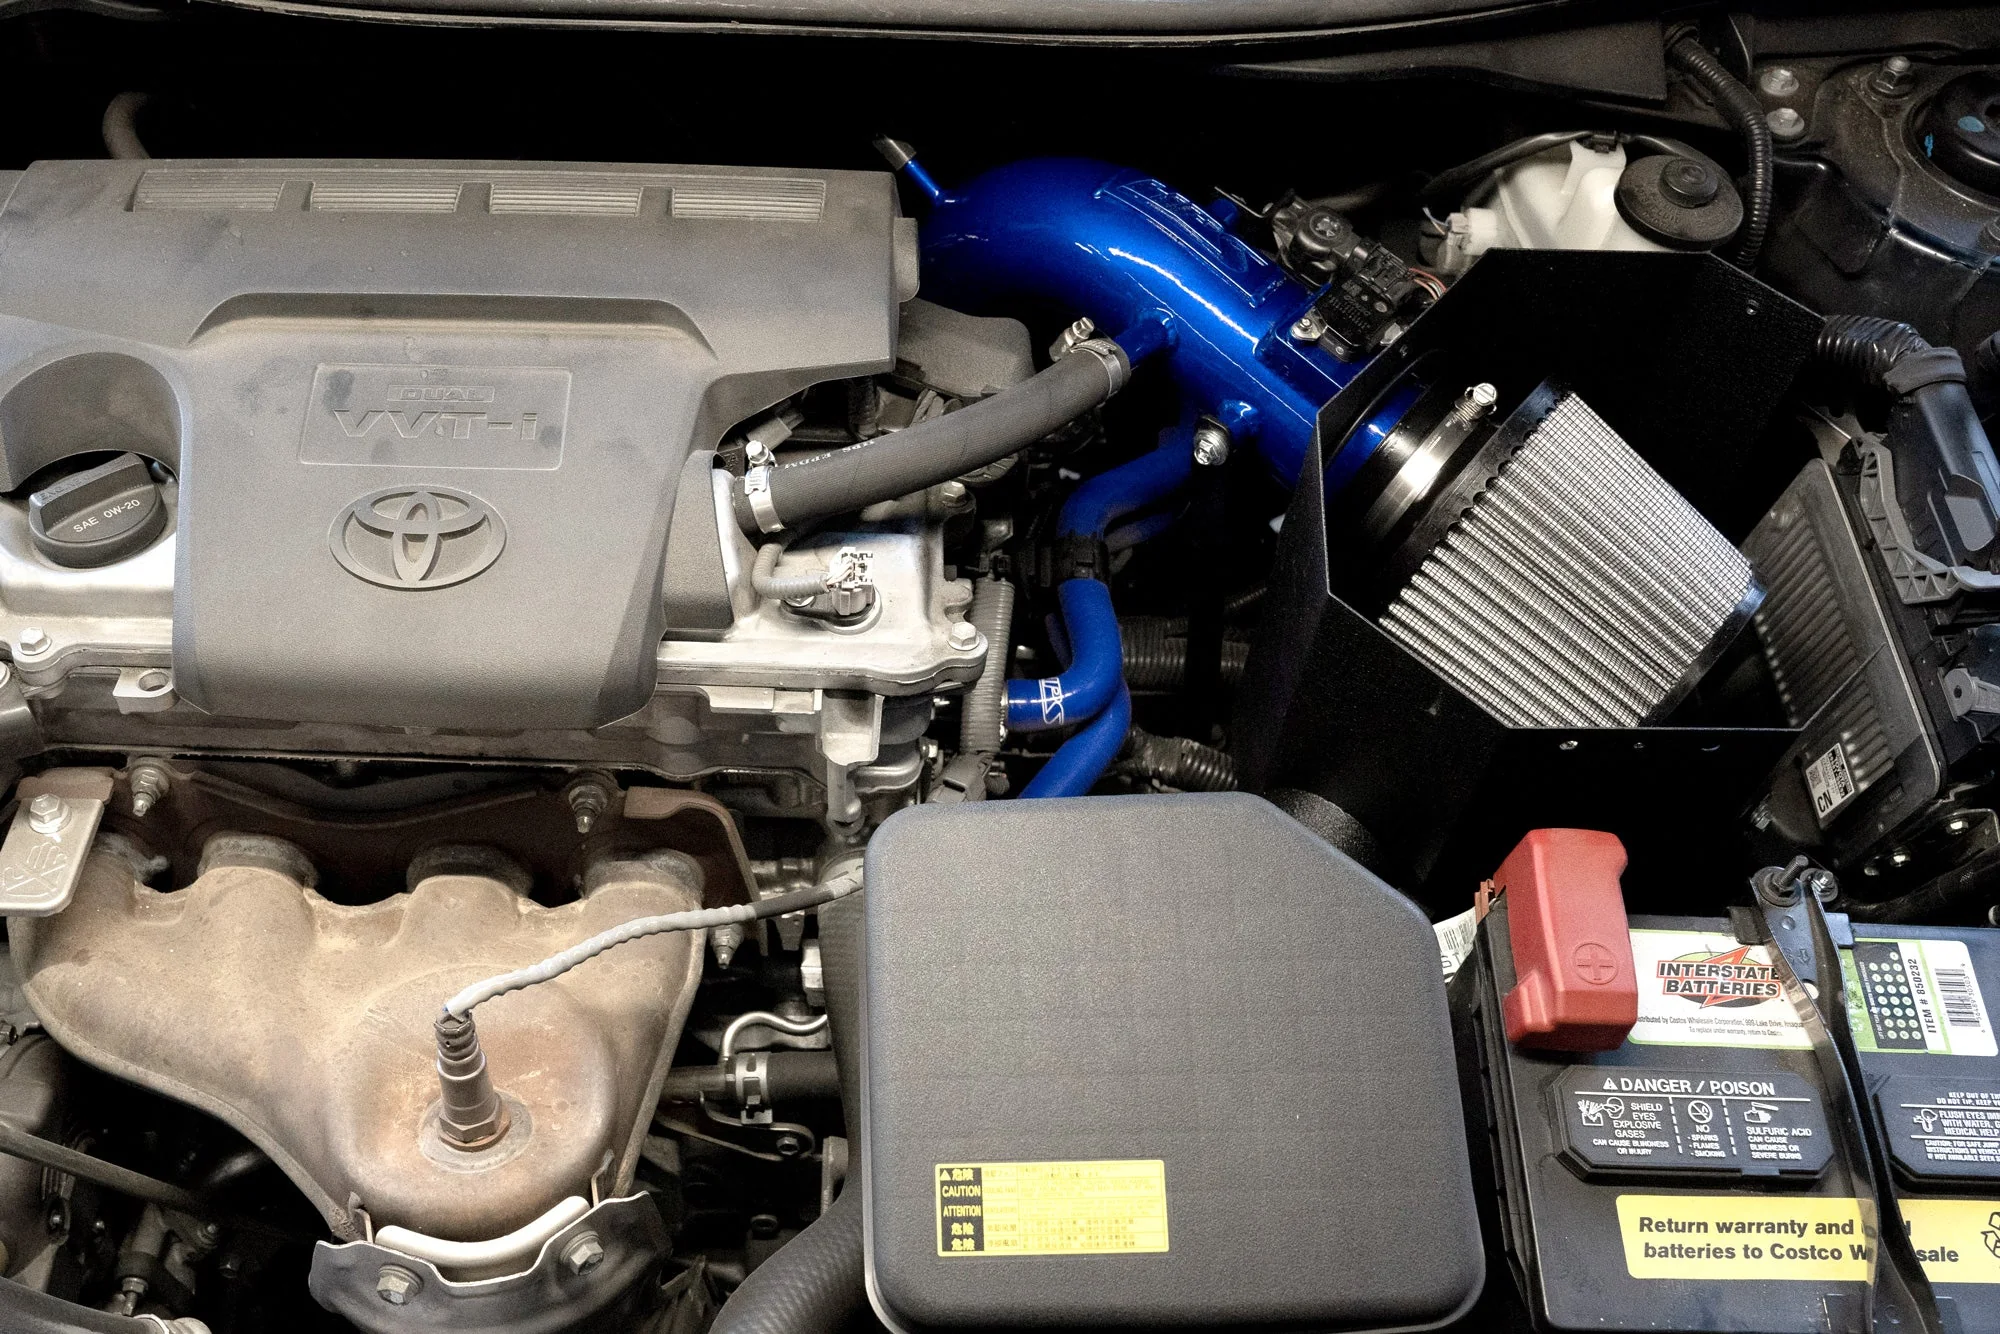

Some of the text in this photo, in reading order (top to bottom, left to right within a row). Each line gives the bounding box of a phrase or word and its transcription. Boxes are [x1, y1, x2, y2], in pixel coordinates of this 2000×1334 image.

[401, 387, 485, 401] DUAL
[73, 499, 141, 533] SAE 0W-20
[1817, 789, 1833, 813] CN
[1659, 963, 1780, 980] INTERSTATE
[1908, 959, 1926, 995] 850232
[1666, 980, 1778, 996] BATTERIES
[1922, 1009, 1937, 1033] ITEM
[1620, 1078, 1775, 1095] DANGER / POISON
[1631, 1102, 1663, 1111] SHIELD
[1633, 1112, 1656, 1120] EYES
[1939, 1110, 1965, 1119] FLUSH
[1966, 1111, 1986, 1119] EYES
[1613, 1120, 1662, 1129] EXPLOSIVE
[1941, 1119, 1963, 1127] WITH
[1963, 1119, 1993, 1128] WATER.
[1615, 1129, 1646, 1138] GASES
[1695, 1125, 1710, 1133] NO
[1746, 1126, 1812, 1136] SULFURIC ACID
[1944, 1127, 1999, 1136] MEDICAL HELP
[1691, 1134, 1719, 1142] SPARKS
[1764, 1136, 1788, 1144] CAUSE
[1593, 1138, 1669, 1148] CAN CAUSE BLINDNESS
[1693, 1142, 1720, 1150] FLAMES
[1617, 1147, 1628, 1155] OR
[1750, 1144, 1787, 1152] BLINDNESS
[1695, 1150, 1726, 1158] SMOKING
[1779, 1152, 1802, 1160] BURNS
[942, 1185, 981, 1197] CAUTION
[943, 1205, 982, 1217] ATTENTION
[1639, 1217, 1708, 1233] Return
[1716, 1219, 1808, 1238] warranty
[1815, 1219, 1854, 1235] and
[1644, 1242, 1959, 1262] batteries to Costco Wsale
